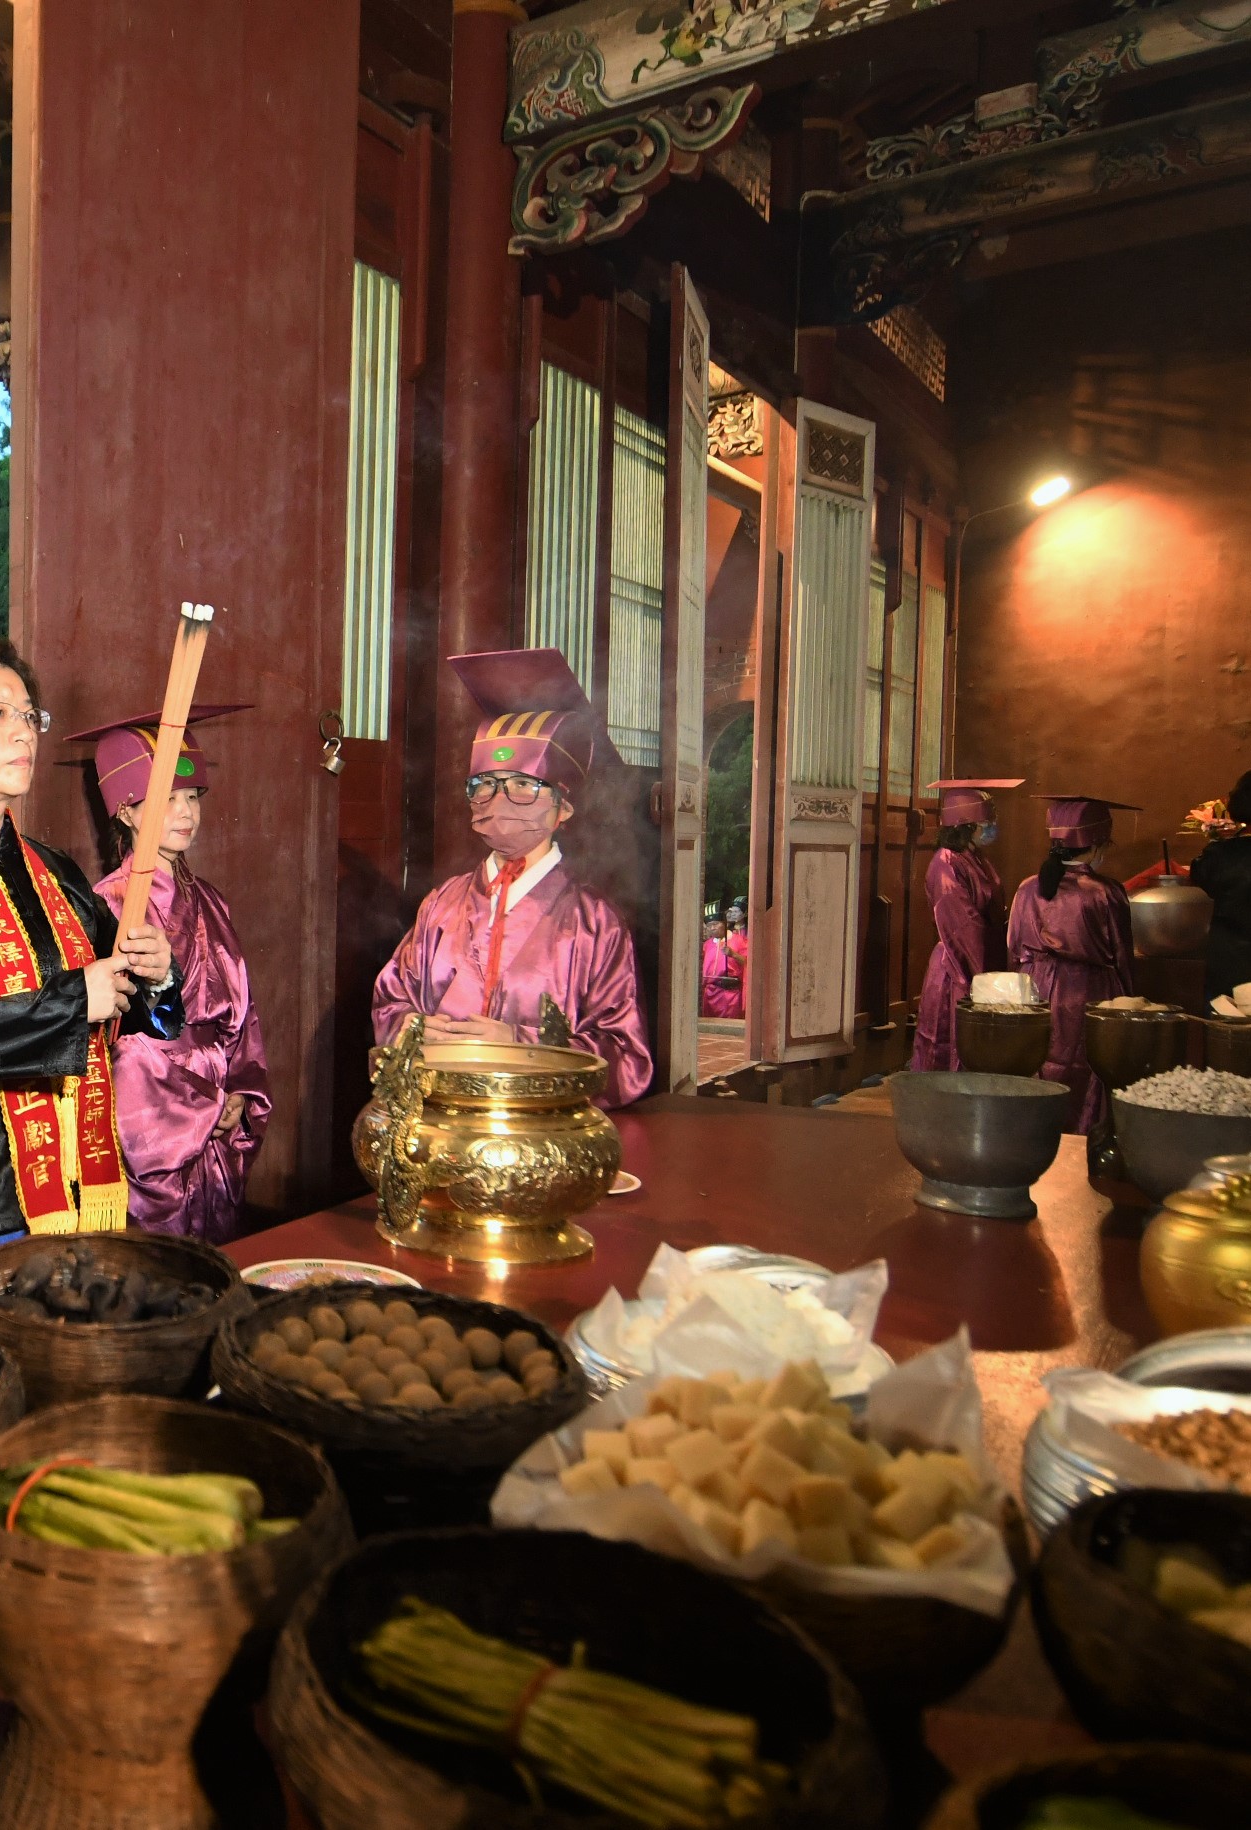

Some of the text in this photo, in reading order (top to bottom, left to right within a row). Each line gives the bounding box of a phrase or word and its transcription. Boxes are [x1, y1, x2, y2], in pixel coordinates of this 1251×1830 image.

[39, 873, 93, 968] 彰化縣各界
[13, 1082, 56, 1190] 正獻官
[82, 1036, 111, 1164] 至聖先師孔子
